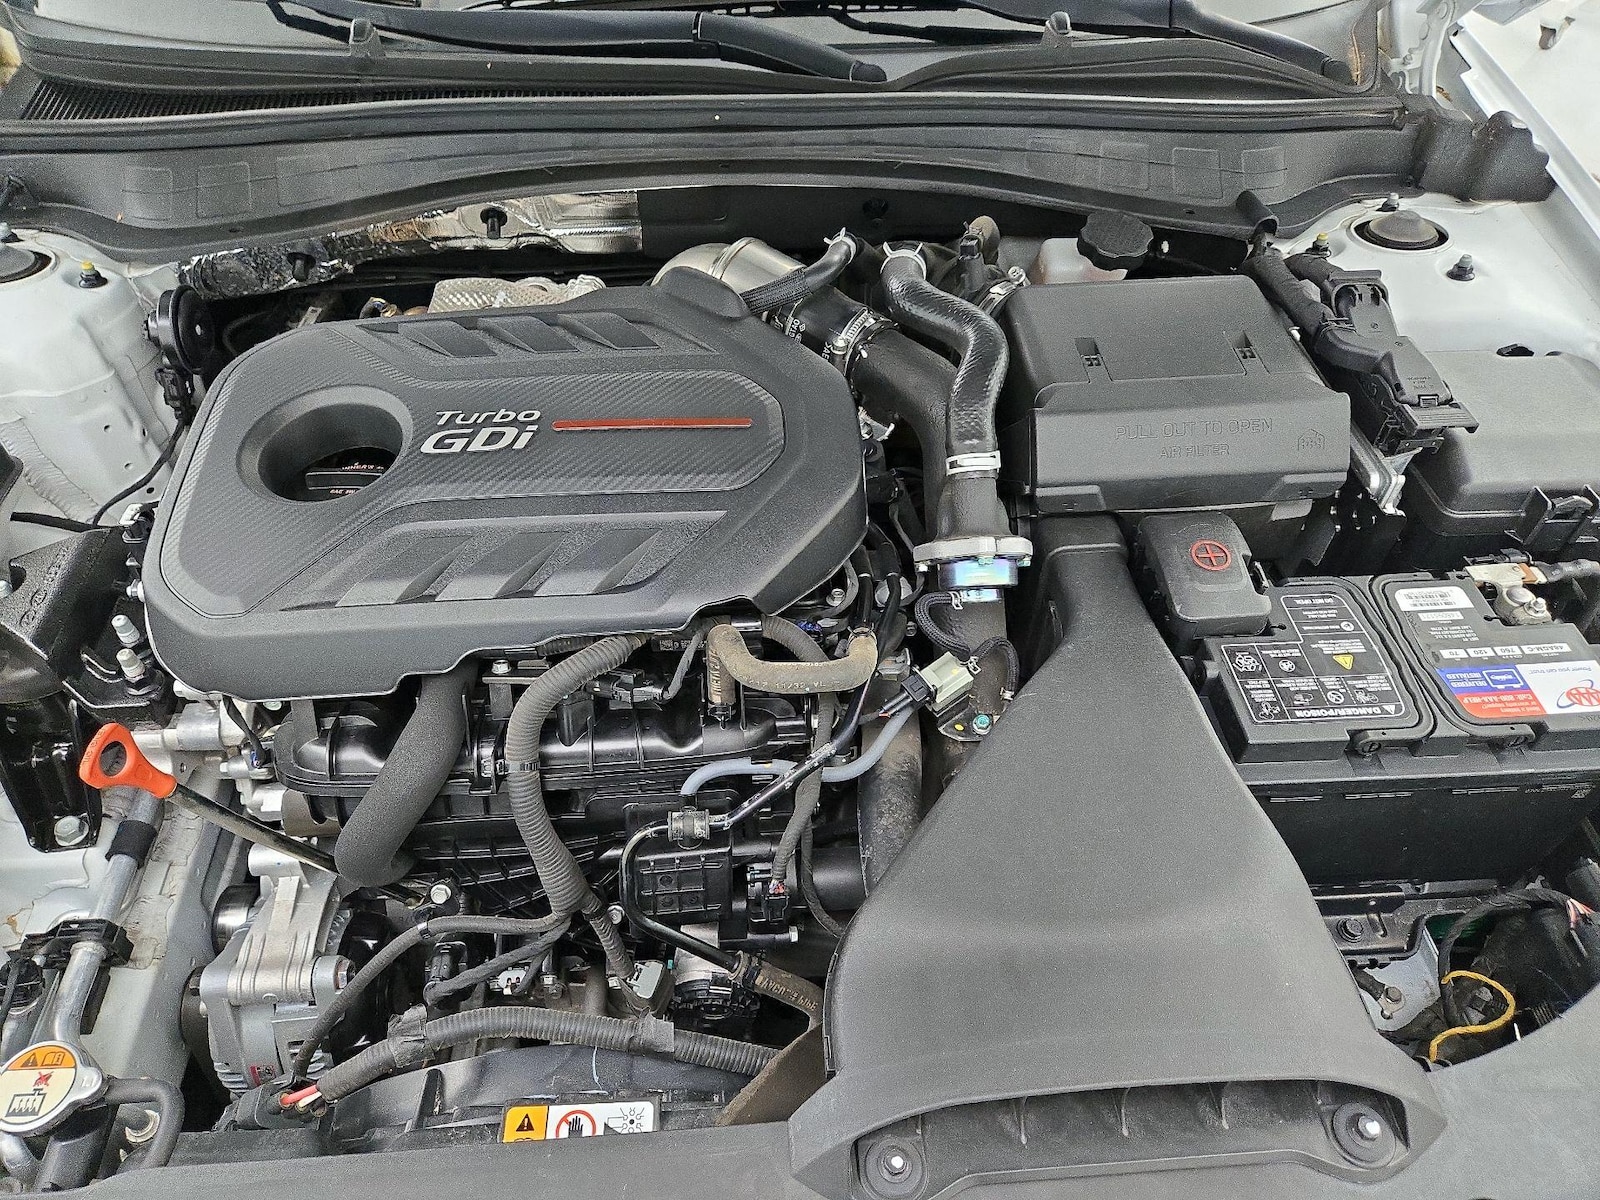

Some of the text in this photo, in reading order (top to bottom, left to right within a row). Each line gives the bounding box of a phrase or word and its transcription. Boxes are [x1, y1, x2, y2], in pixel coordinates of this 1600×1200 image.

[435, 408, 541, 426] Turbo
[1114, 418, 1273, 440] PULL OUT TO OPEN
[420, 424, 539, 454] GDi
[1158, 443, 1231, 460] AIR FILTER
[1526, 645, 1564, 653] 48AGM-C
[1450, 680, 1488, 688] DELIVERED
[1294, 706, 1382, 717] DANGER/POISON
